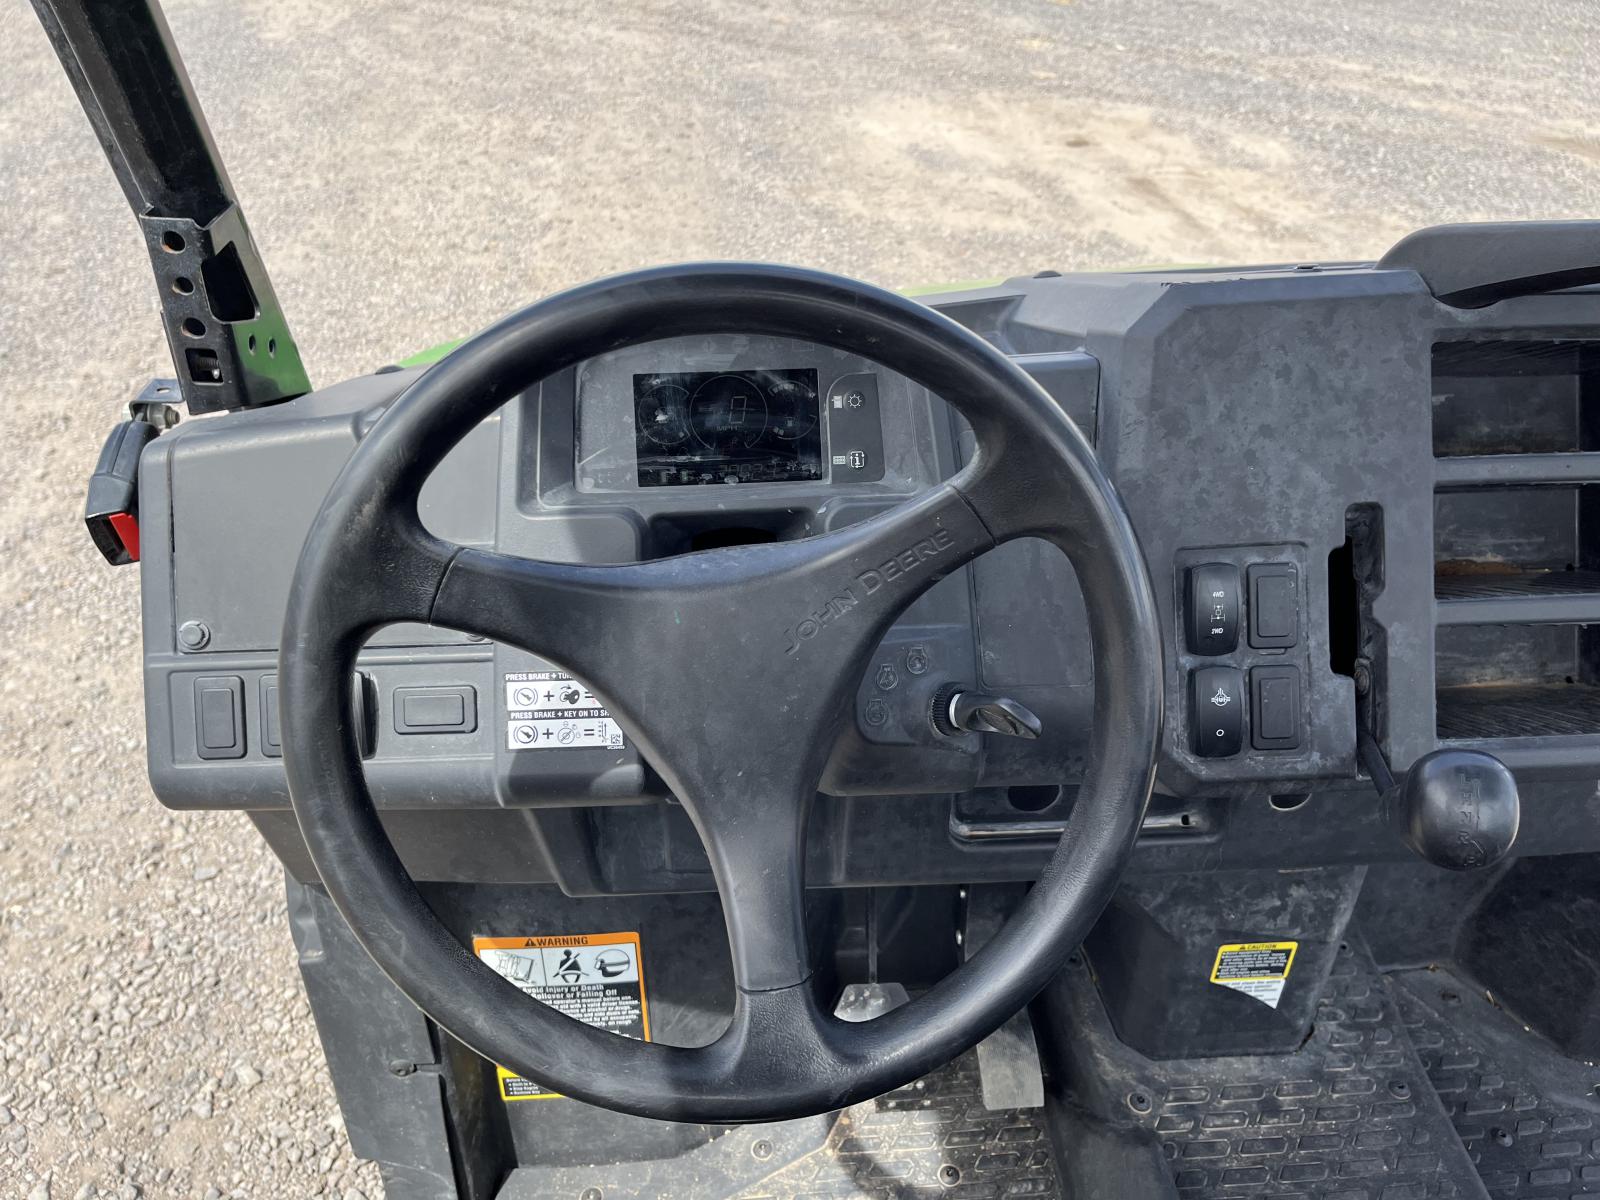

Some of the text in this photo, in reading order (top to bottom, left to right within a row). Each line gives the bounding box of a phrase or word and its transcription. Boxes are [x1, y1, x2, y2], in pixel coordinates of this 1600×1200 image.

[784, 528, 955, 656] JOHN DEERE
[505, 673, 527, 681] PRESS
[528, 672, 550, 680] BRAKE
[510, 712, 533, 720] PRESS
[534, 711, 556, 719] BRAKE
[536, 936, 589, 946] WARNING
[546, 985, 568, 994] Injury
[577, 990, 604, 998] Falling
